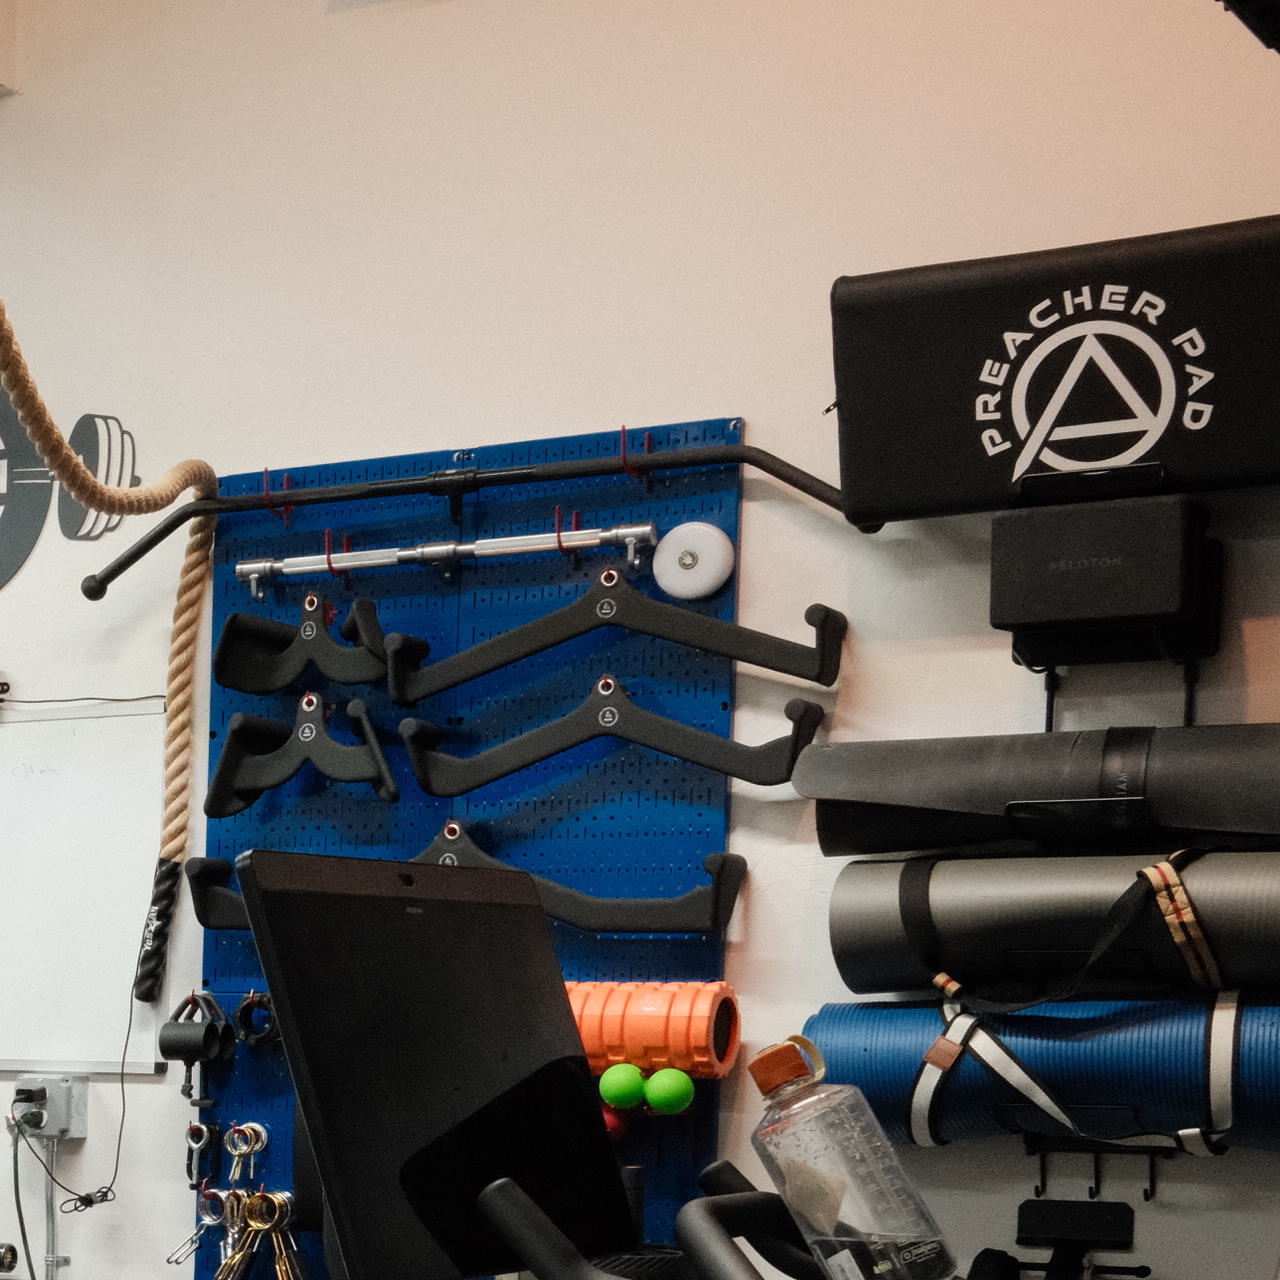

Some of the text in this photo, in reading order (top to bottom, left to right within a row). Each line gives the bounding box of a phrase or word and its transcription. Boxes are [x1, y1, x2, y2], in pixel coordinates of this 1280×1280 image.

[975, 284, 1215, 457] PREACHER PAD
[1049, 554, 1123, 571] PELOTON
